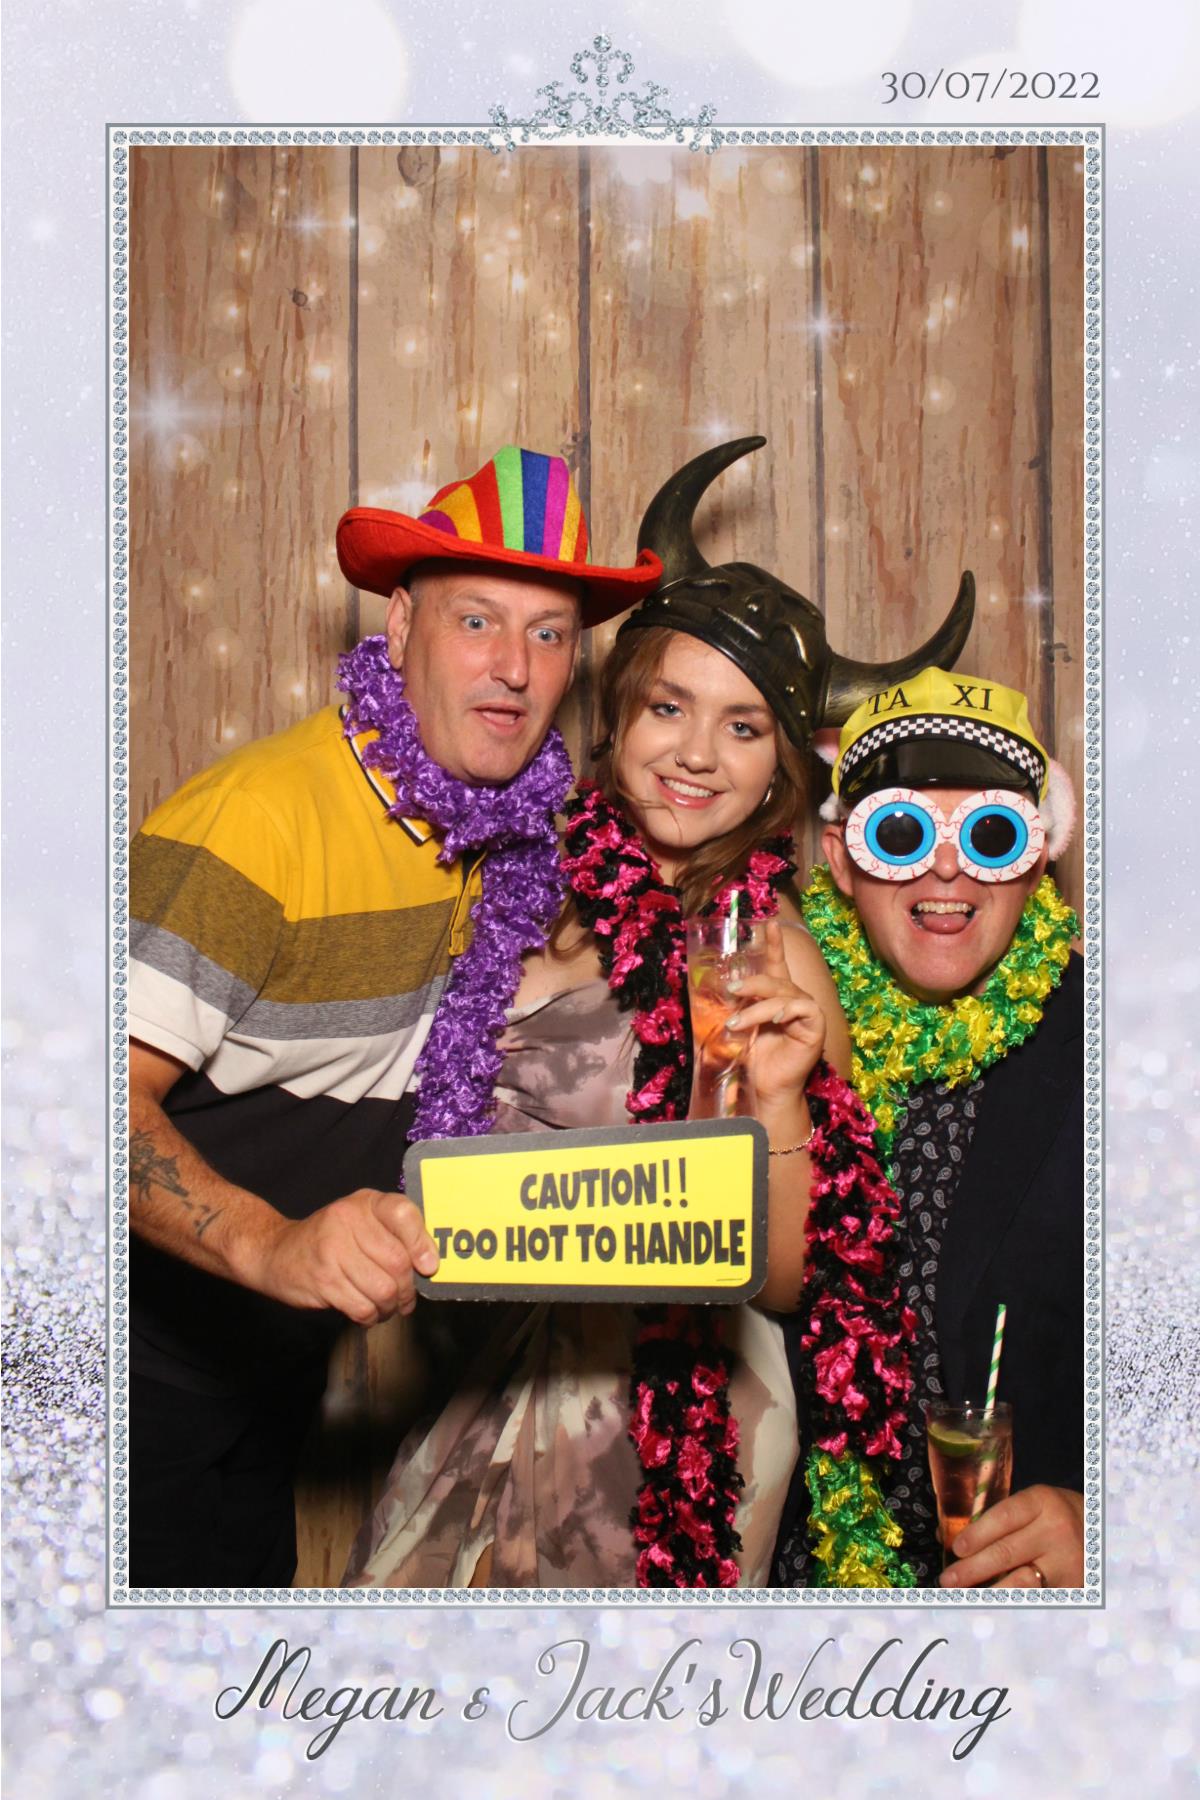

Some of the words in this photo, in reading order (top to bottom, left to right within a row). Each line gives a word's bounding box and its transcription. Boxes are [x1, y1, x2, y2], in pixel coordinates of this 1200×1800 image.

[520, 1157, 688, 1210] CAUTION!!
[434, 1227, 497, 1260] TOO
[506, 1225, 568, 1262] HOT
[576, 1224, 616, 1262] TO
[624, 1219, 745, 1266] HANDLE
